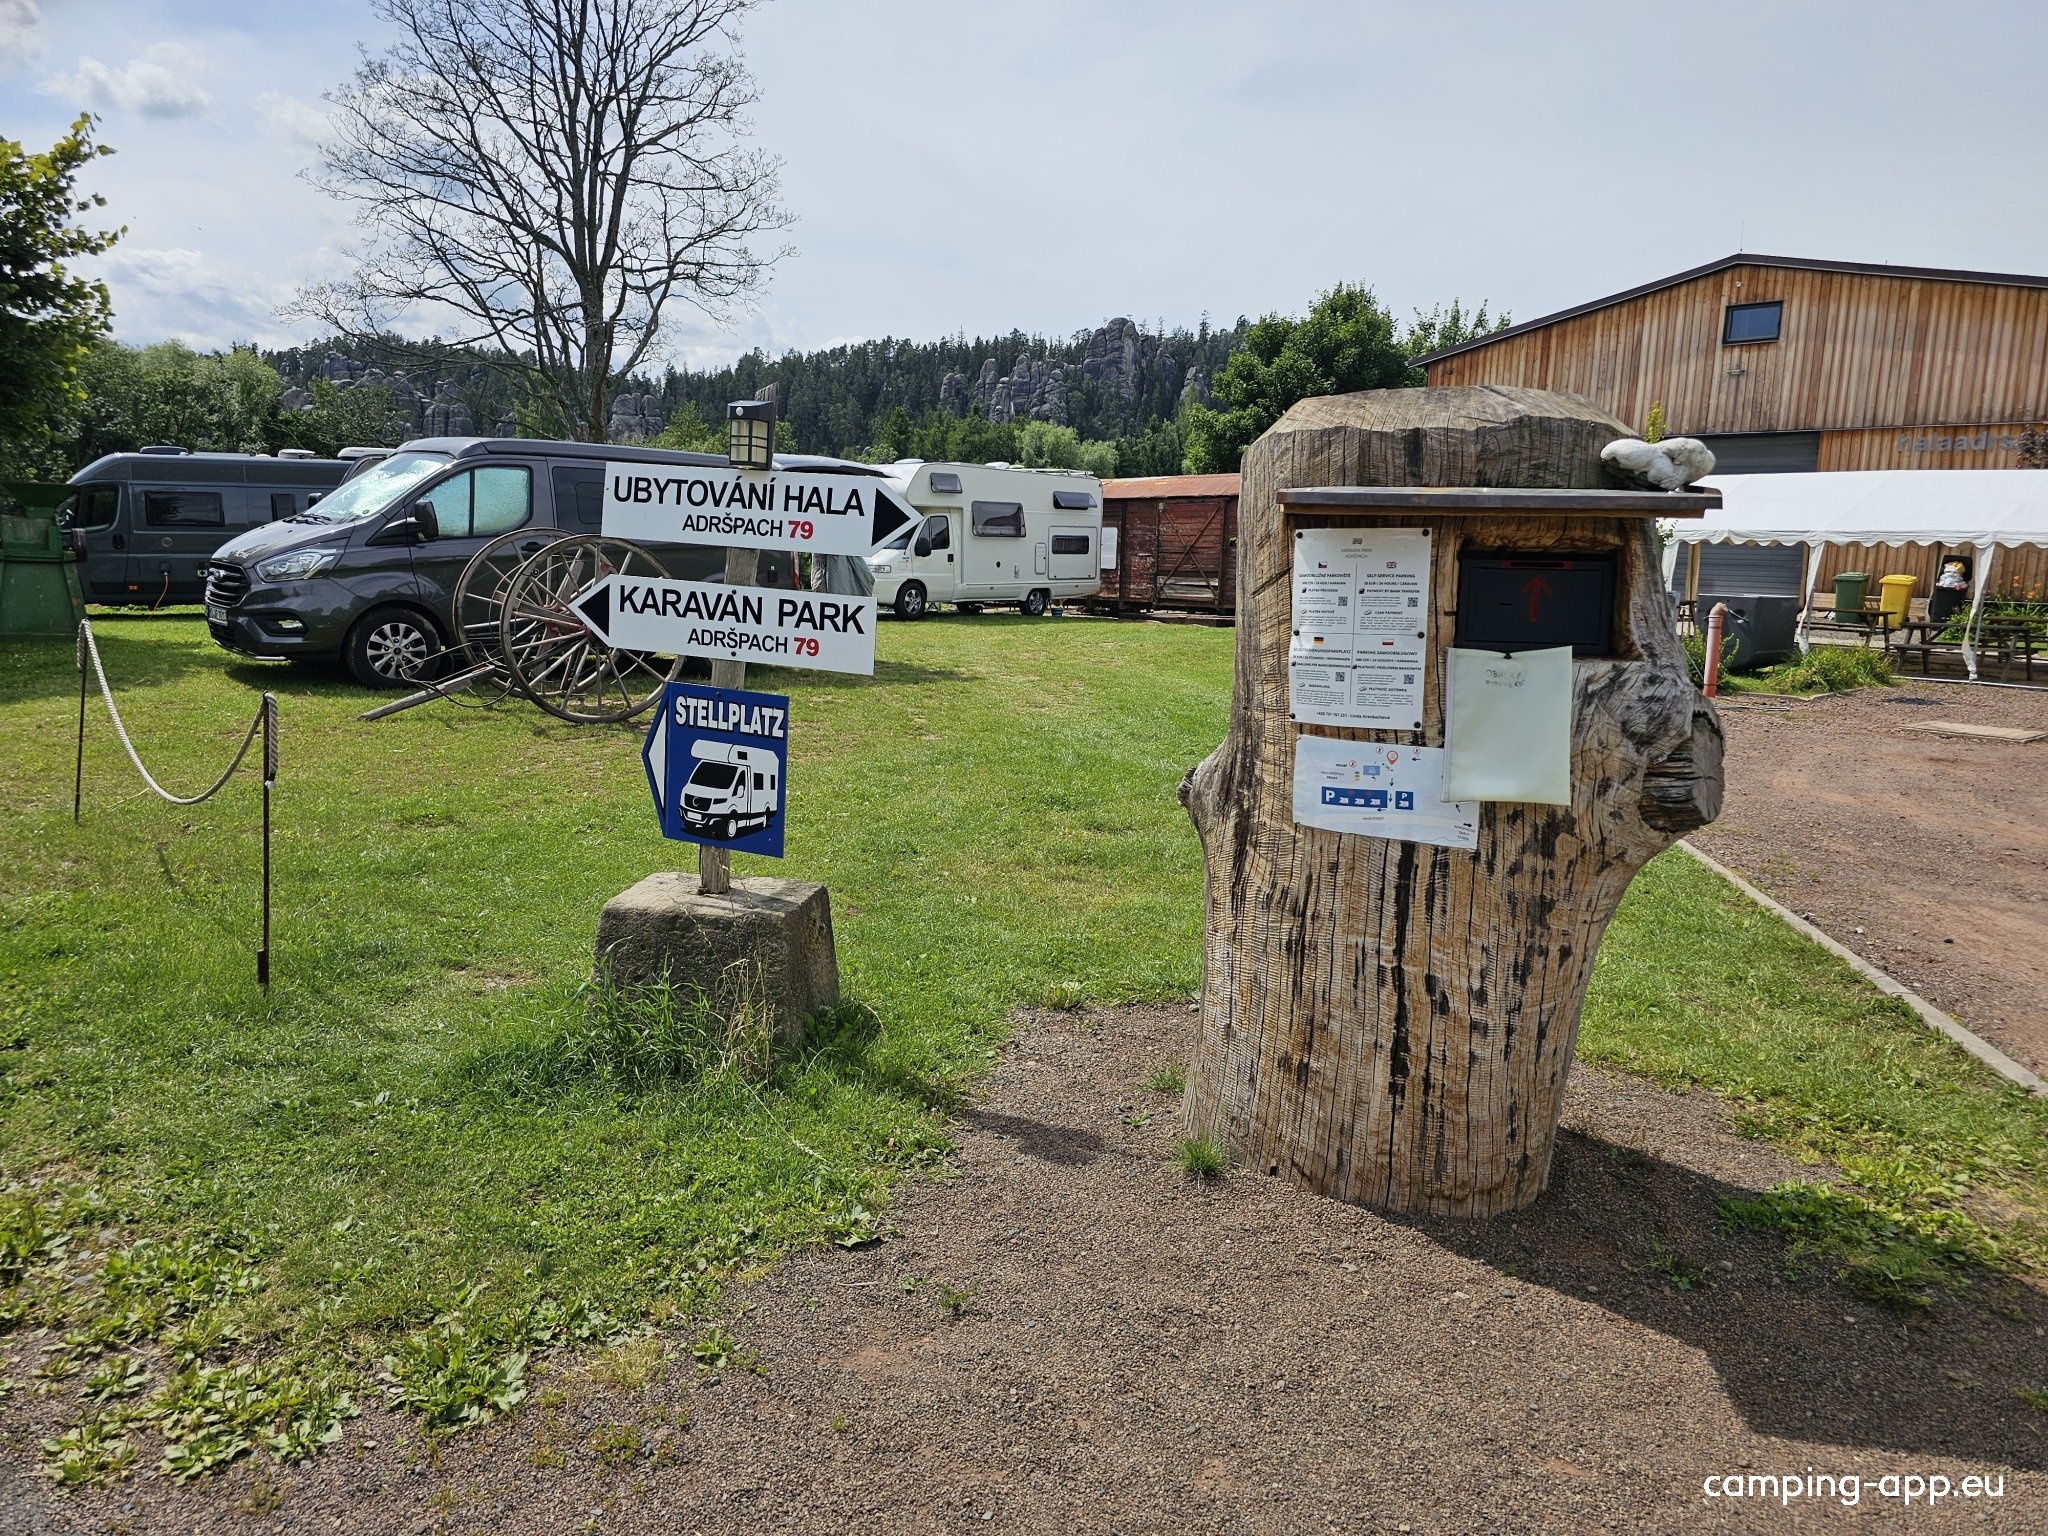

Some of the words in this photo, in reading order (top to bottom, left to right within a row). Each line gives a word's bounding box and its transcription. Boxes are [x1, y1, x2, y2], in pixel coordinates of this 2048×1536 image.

[1897, 430, 2018, 453] halaadrs
[614, 475, 776, 511] UBYTOVÁNÍ
[784, 484, 865, 517] HALA
[682, 512, 783, 538] ADRŠPACH
[788, 520, 814, 540] 79
[778, 598, 865, 635] PARK
[687, 627, 788, 654] ADRŠPACH
[793, 637, 820, 657] 79
[676, 696, 785, 738] STELLPLATZ
[1325, 789, 1336, 802] P
